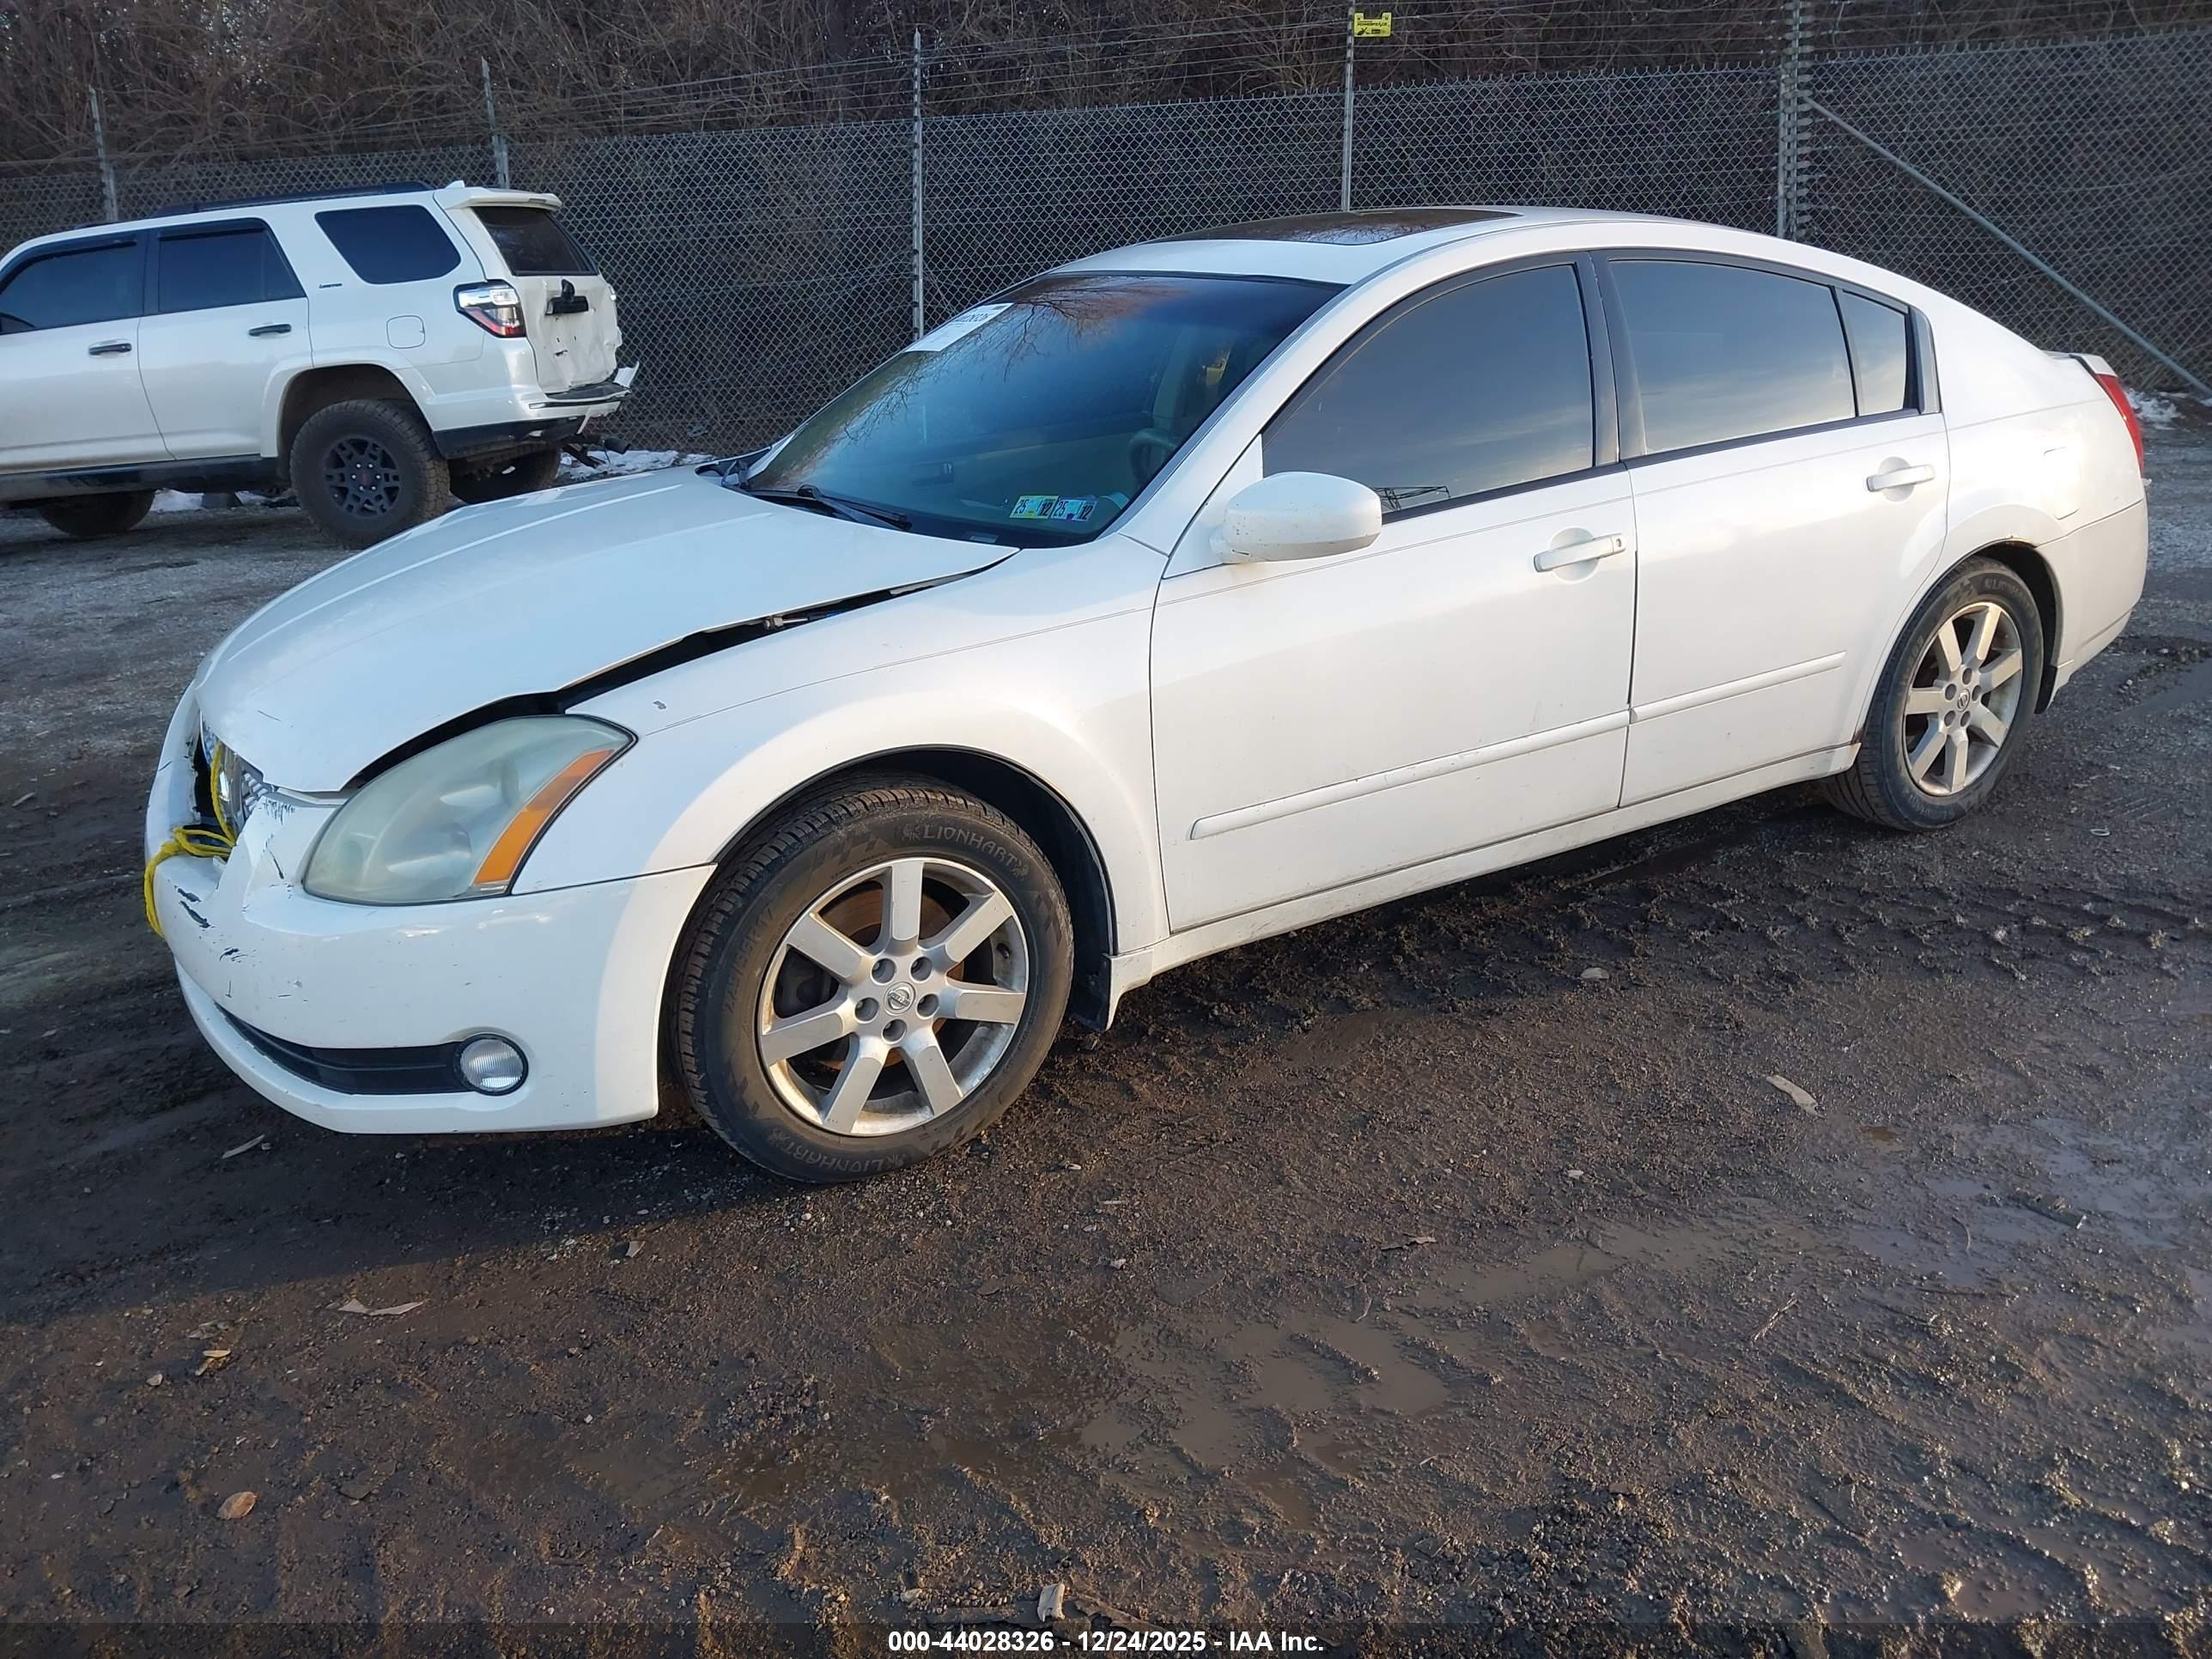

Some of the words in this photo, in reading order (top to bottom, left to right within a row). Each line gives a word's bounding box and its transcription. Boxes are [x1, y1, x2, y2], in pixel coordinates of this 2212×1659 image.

[1014, 500, 1030, 515] 25
[1039, 502, 1054, 517] 12
[1053, 501, 1069, 517] 25
[1079, 505, 1094, 520] 12
[922, 824, 1018, 867] LIONHART
